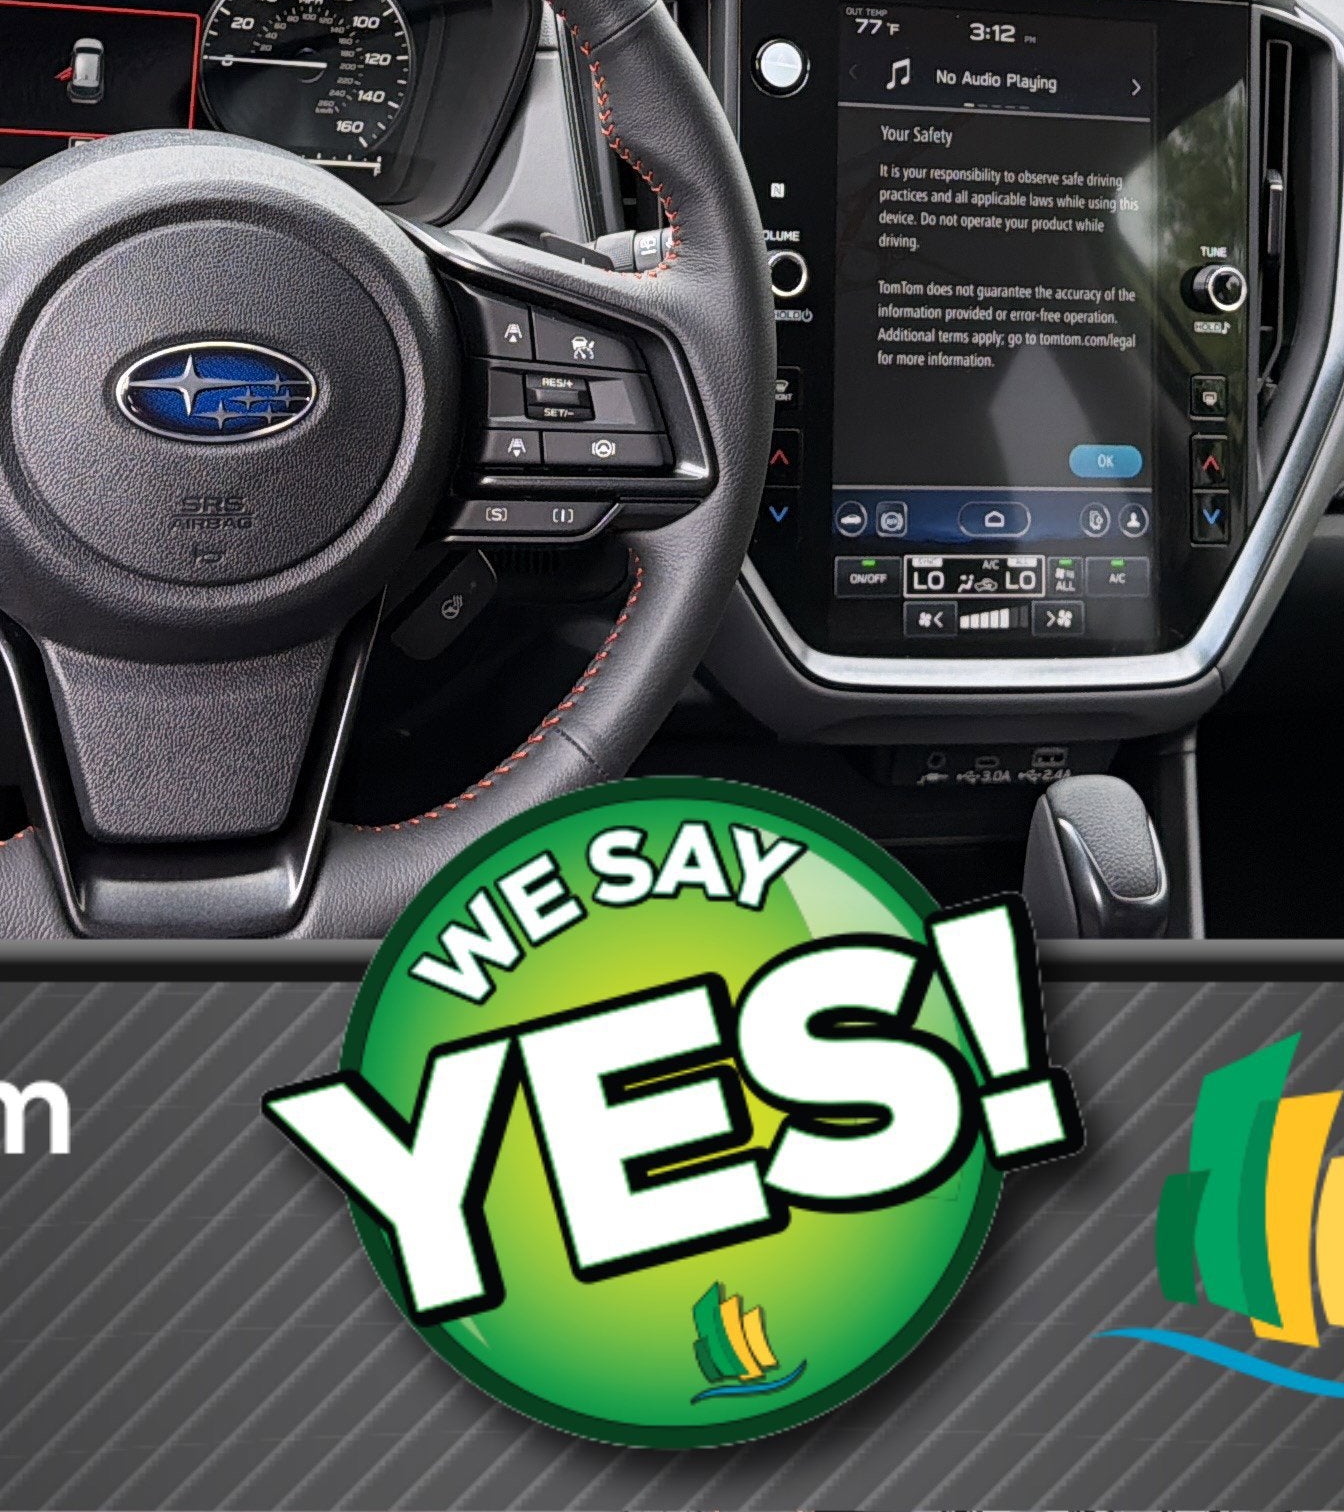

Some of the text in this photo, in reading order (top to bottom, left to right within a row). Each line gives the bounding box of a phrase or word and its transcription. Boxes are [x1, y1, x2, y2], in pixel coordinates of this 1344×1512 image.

[845, 6, 863, 17] OUT
[230, 17, 255, 30] 20
[352, 16, 380, 29] 100
[854, 18, 883, 35] 77
[969, 23, 1016, 43] 3:12
[364, 53, 392, 66] 120
[936, 69, 1057, 94] No Audio Playing
[357, 90, 385, 103] 140
[336, 120, 364, 133] 160
[880, 125, 953, 148] Your Safety
[880, 164, 1123, 191] It is your responsibility to observe safe driving
[879, 188, 1139, 213] practices and all applicable laws while using this
[878, 210, 1104, 234] device. Do not operate your product while
[762, 229, 801, 242] OLUME
[878, 233, 920, 252] driving.
[1200, 245, 1228, 258] TUNE
[878, 280, 1136, 304] TomTom does not guarantee the accuracy of the
[878, 303, 1118, 326] information provided or error-free operation.
[878, 327, 935, 343] Additional
[937, 329, 969, 344] terms
[1007, 334, 1022, 348] go
[1025, 332, 1036, 345] to
[1039, 332, 1136, 351] tomtom.com/legal
[877, 350, 995, 368] for more information.
[1097, 454, 1114, 468] OK
[181, 496, 246, 513] SRS
[170, 517, 253, 530] AIRBAG
[982, 559, 1000, 570] A/C
[849, 573, 887, 585] ON/OFF
[913, 570, 945, 590] LO
[1005, 570, 1036, 590] LO
[1055, 580, 1076, 593] ALL
[1108, 573, 1126, 585] A/C
[981, 769, 1011, 783] 3.0A
